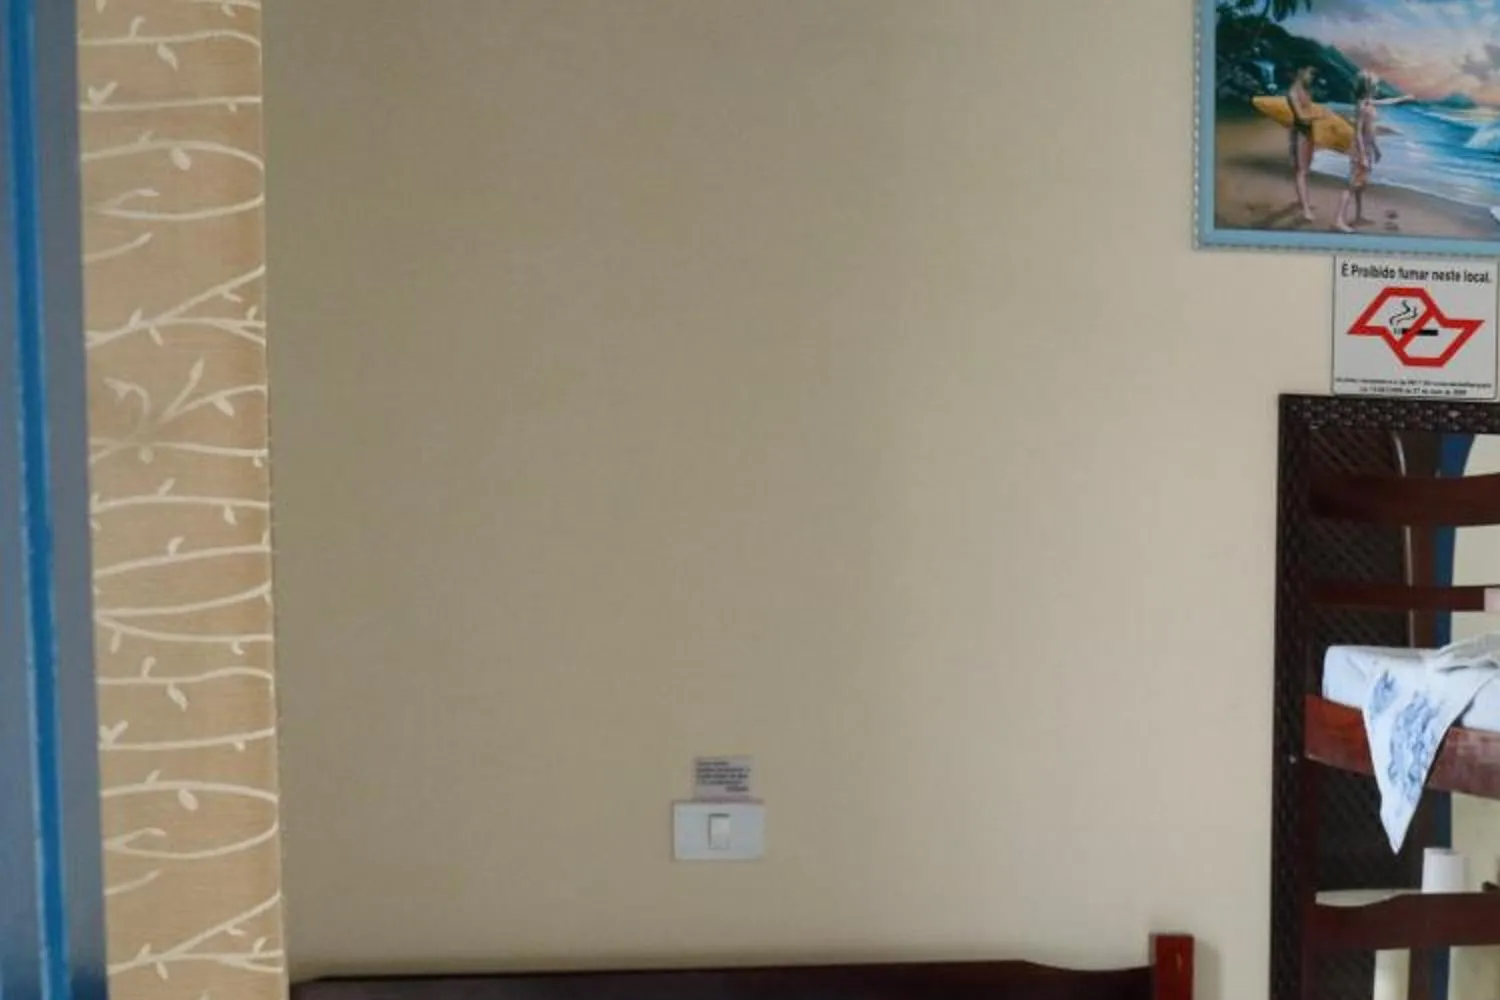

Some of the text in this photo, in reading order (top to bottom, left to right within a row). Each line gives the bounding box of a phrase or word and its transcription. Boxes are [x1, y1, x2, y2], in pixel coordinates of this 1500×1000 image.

[1351, 263, 1396, 280] Proibido
[1398, 266, 1429, 281] fumar
[1431, 269, 1461, 283] neste
